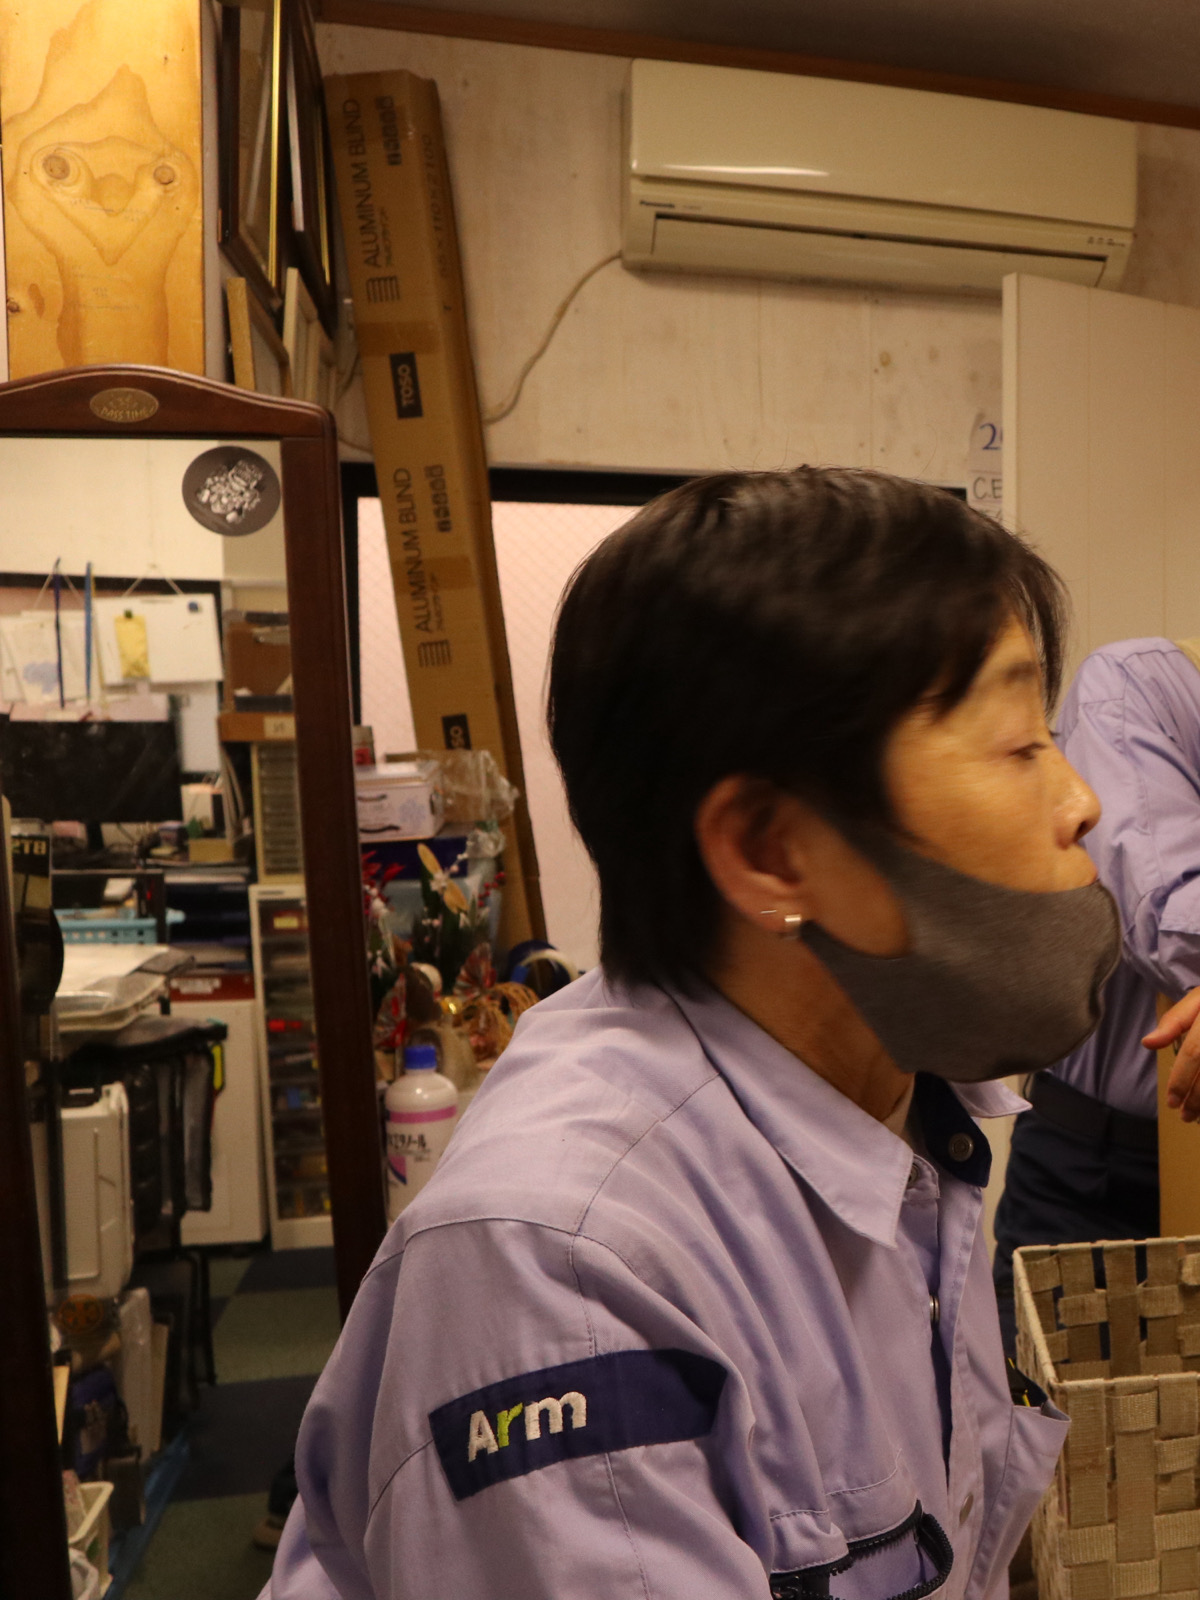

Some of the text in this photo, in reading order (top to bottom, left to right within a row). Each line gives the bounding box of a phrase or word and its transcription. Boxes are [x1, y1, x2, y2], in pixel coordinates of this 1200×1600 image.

[343, 98, 381, 268] ALUMINUM BLIND
[397, 363, 414, 408] TOSO
[393, 467, 433, 634] ALUMINUM BLIND
[467, 1390, 588, 1463] Arm
